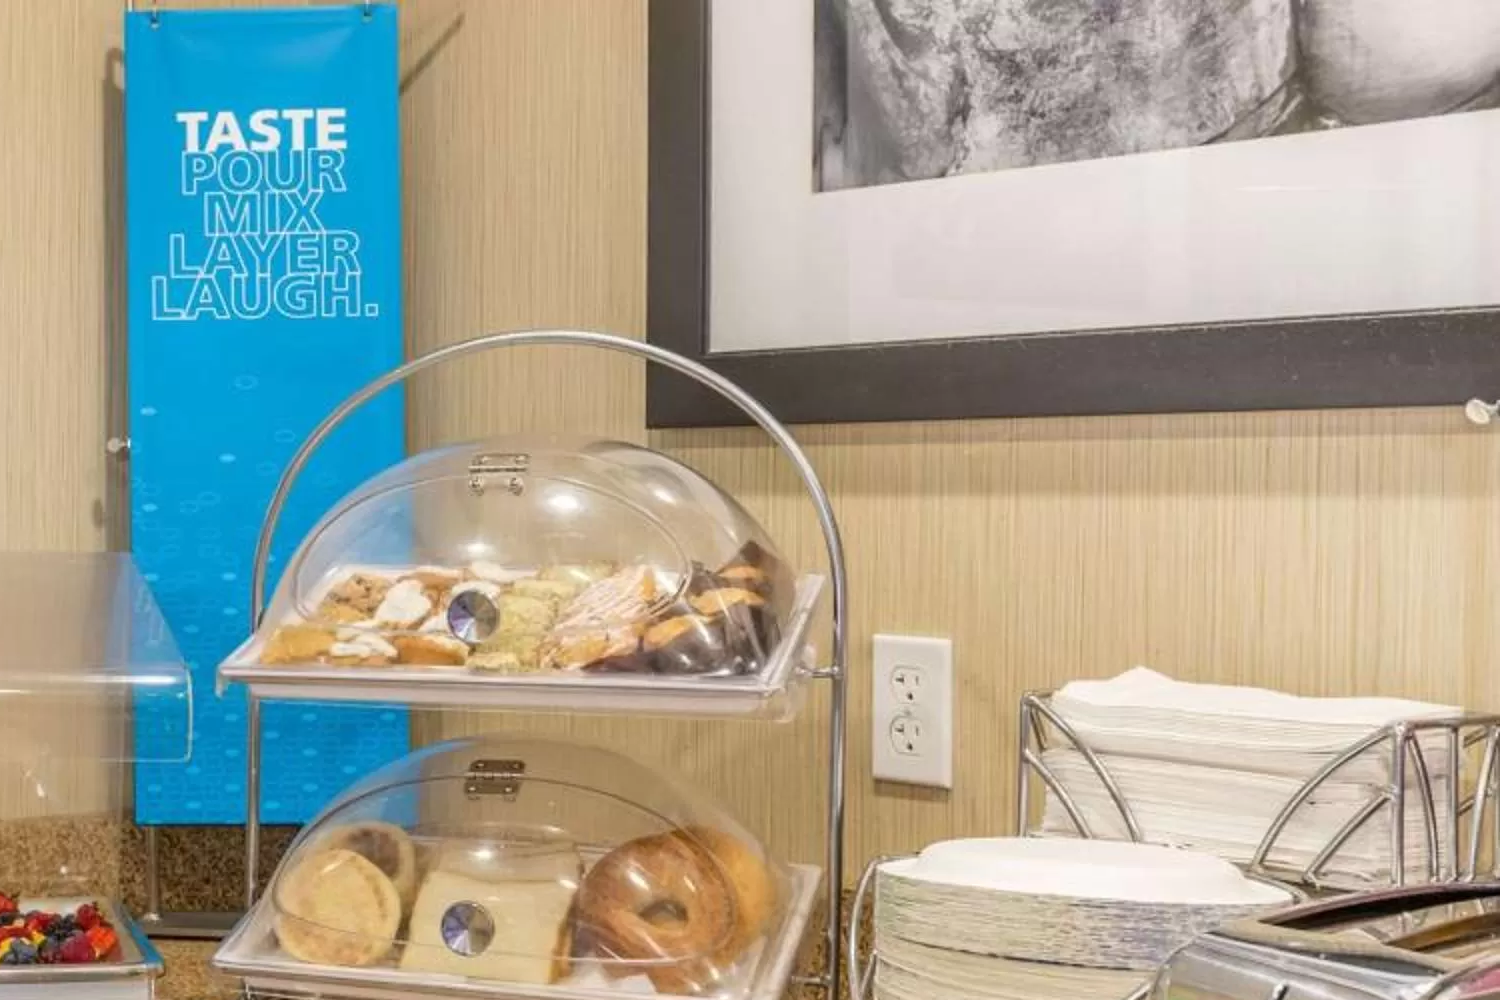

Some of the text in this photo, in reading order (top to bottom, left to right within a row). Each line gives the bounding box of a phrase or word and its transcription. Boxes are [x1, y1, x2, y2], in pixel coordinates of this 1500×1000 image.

[175, 108, 347, 153] TASTE
[181, 148, 346, 195] POUR
[204, 189, 326, 237] MIX
[169, 230, 362, 278] LAYER
[152, 273, 379, 320] LAUGH.
